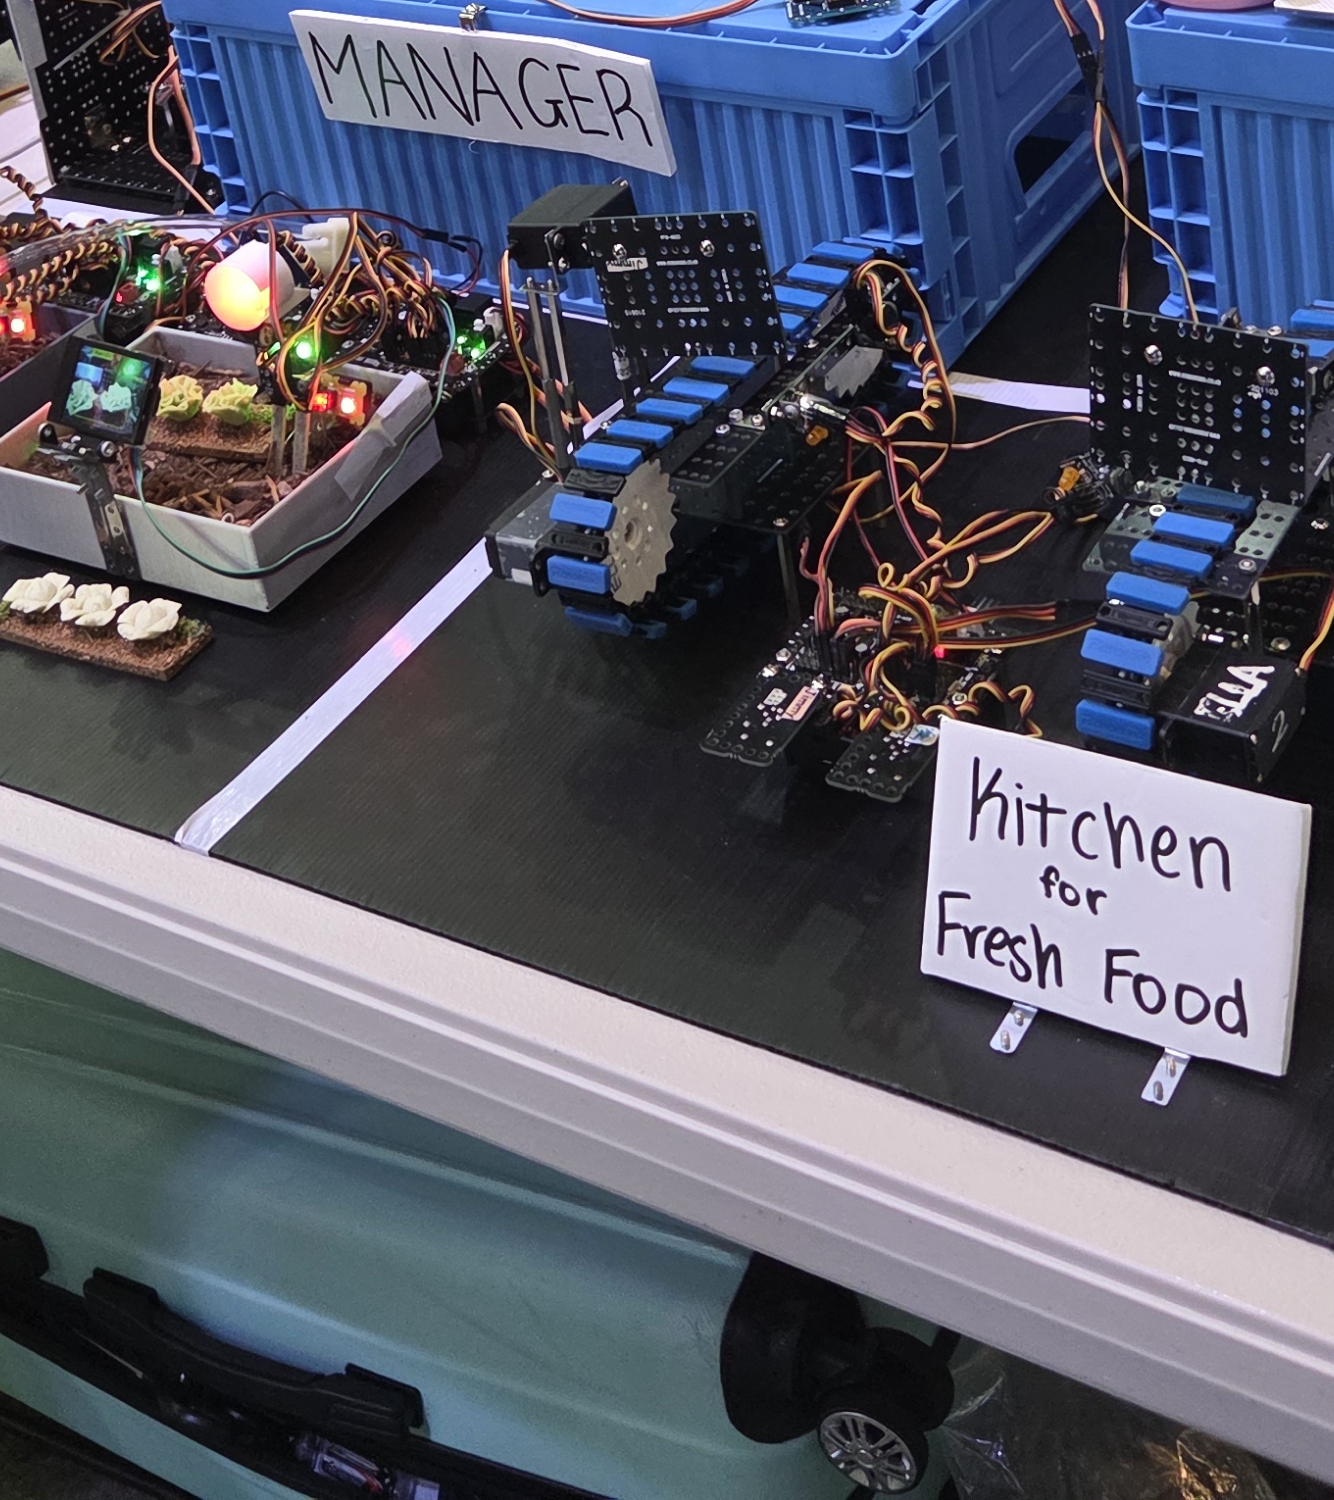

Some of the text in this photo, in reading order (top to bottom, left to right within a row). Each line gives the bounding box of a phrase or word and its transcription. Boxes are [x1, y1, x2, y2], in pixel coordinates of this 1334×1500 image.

[308, 31, 653, 147] MANAGER
[970, 756, 1231, 892] Kitchen
[1039, 865, 1108, 916] for
[937, 890, 1249, 1039] Fresh Food
